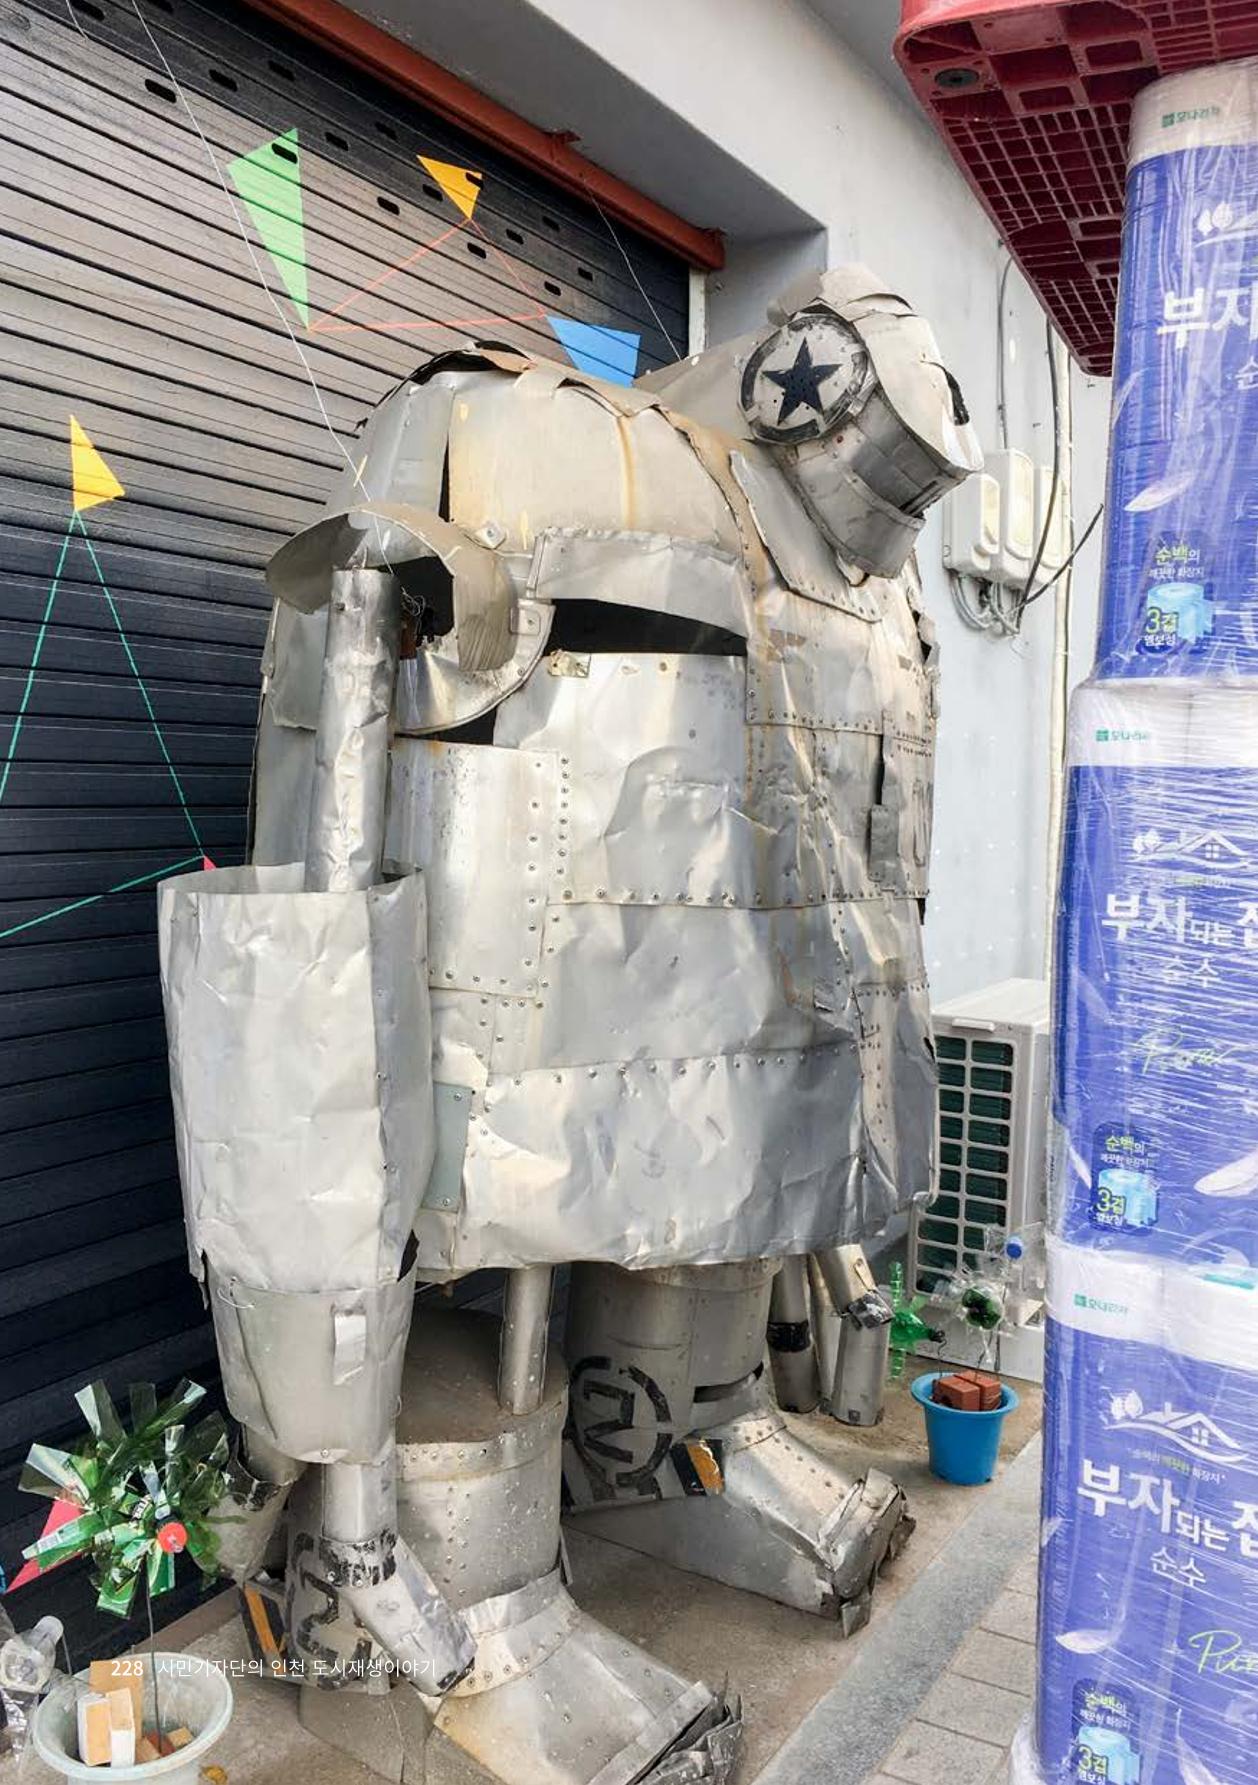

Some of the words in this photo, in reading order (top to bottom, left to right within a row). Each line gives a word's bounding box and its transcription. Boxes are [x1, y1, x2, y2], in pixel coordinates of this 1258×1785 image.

[1155, 544, 1201, 566] 순백의
[1145, 607, 1178, 634] 3겹
[1097, 1188, 1125, 1216] 3겹
[1150, 1546, 1207, 1588] 순수
[1078, 1746, 1106, 1775] 3겹
